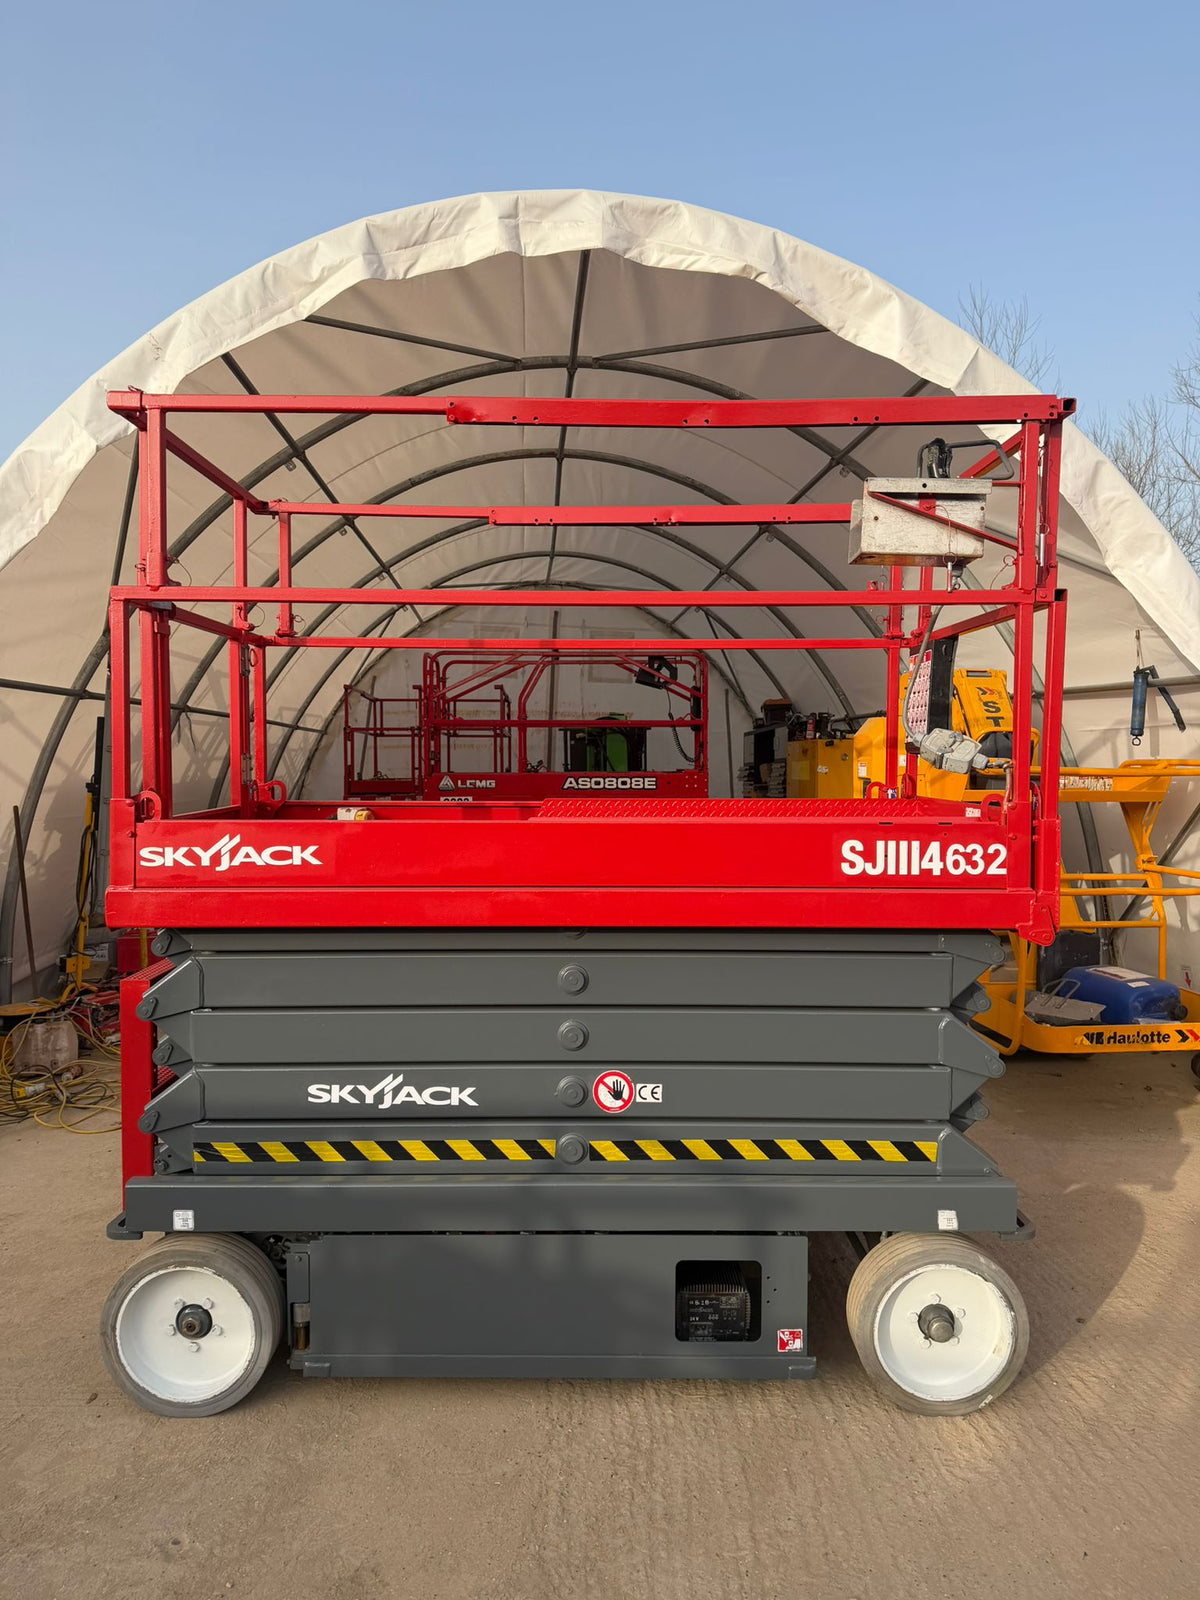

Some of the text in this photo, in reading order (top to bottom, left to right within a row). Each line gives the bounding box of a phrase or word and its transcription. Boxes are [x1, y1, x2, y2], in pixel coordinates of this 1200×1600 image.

[139, 833, 323, 872] SKYJACK
[1106, 1030, 1171, 1045] Haulotte
[307, 1073, 479, 1109] SKYJACK
[638, 1085, 661, 1101] CE
